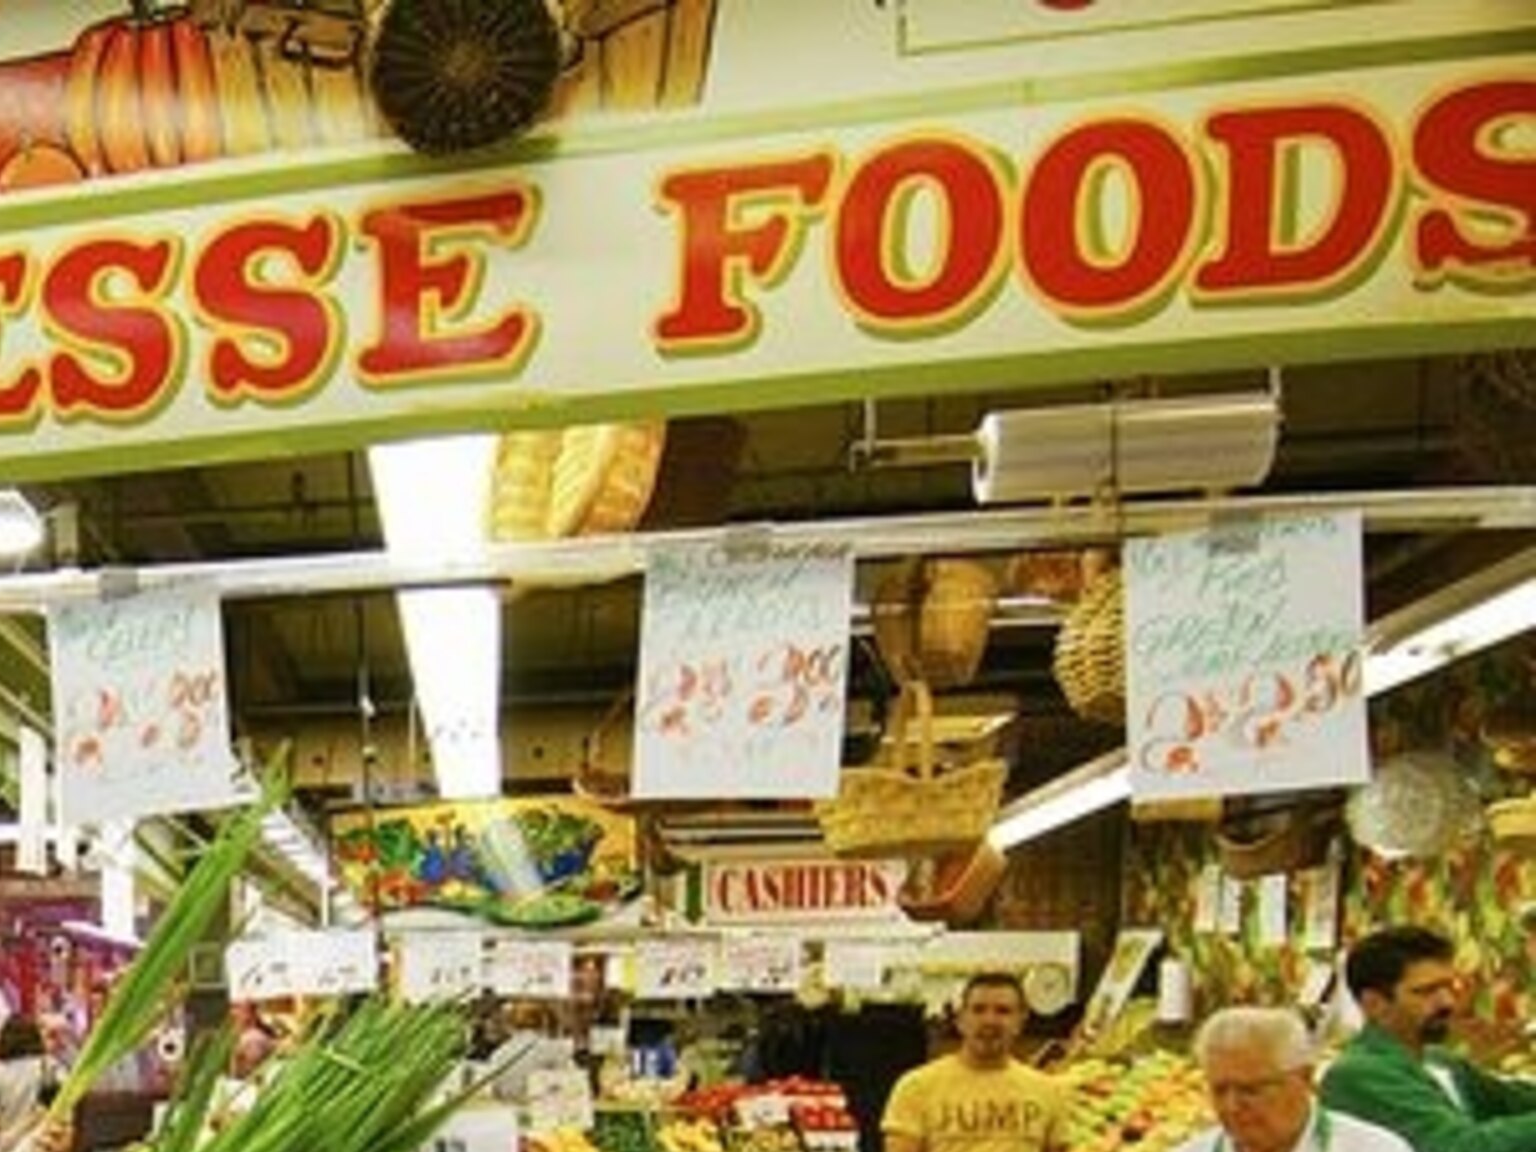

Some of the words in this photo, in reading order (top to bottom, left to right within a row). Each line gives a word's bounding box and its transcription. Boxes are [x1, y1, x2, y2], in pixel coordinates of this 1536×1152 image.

[654, 76, 1536, 354] FOODS
[717, 864, 890, 913] CASHIERS
[936, 1099, 1041, 1133] JUMP
